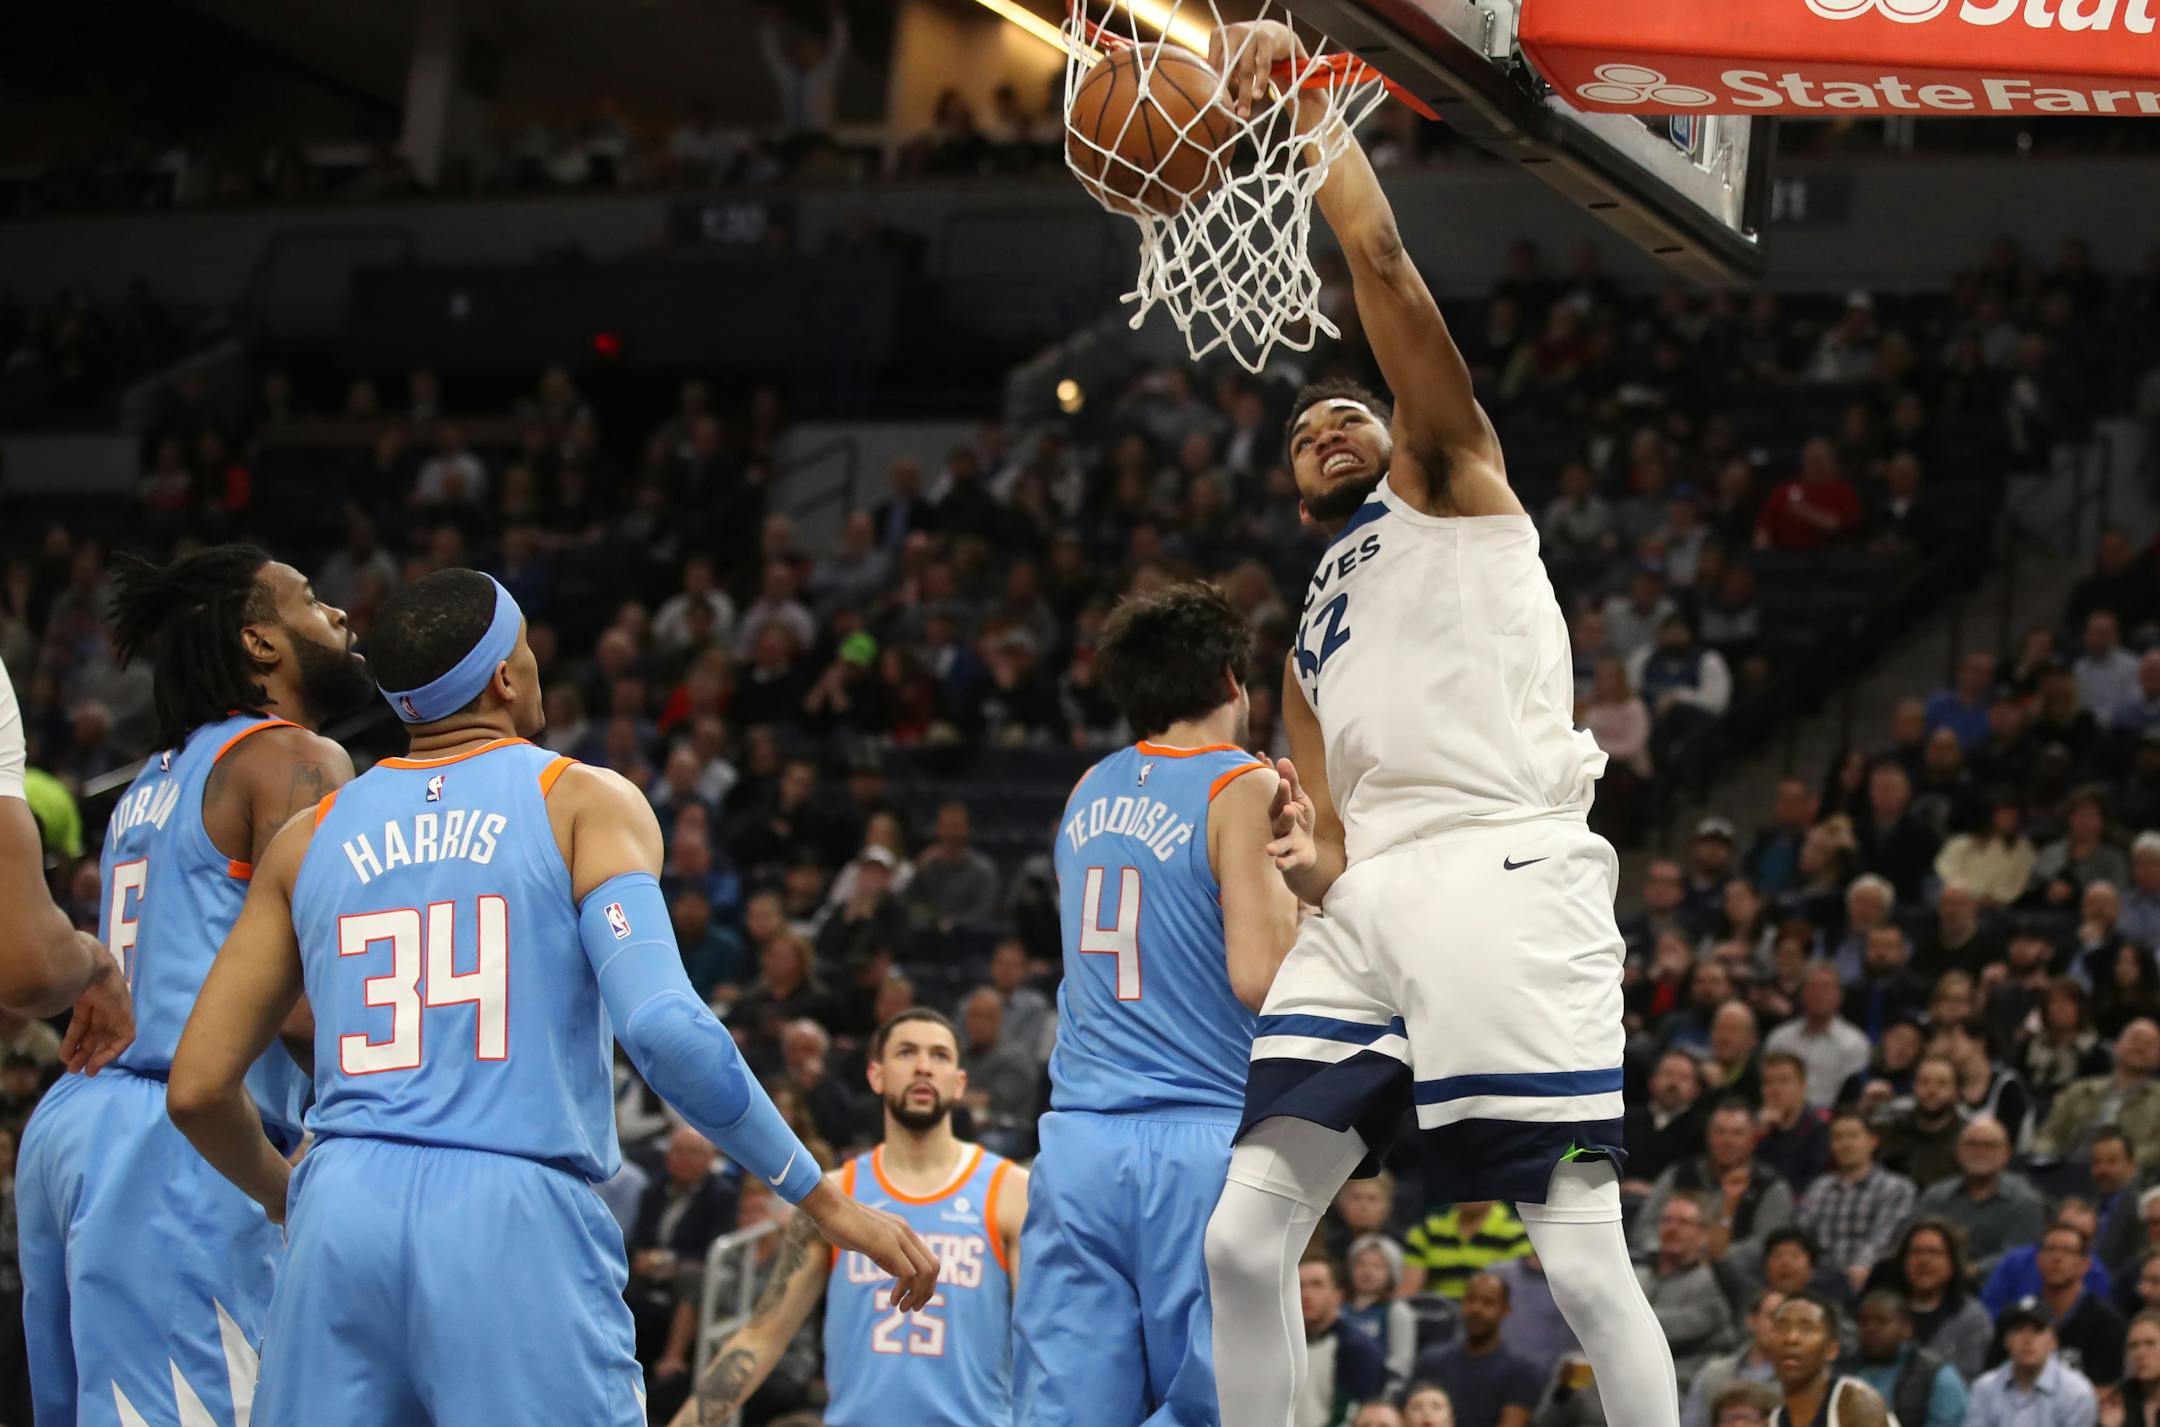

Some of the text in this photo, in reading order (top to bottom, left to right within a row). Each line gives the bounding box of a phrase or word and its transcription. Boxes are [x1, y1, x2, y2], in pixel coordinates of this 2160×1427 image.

[1303, 534, 1381, 613] VES
[342, 809, 507, 884] HARRIS
[1080, 866, 1142, 1001] 4
[338, 894, 509, 1077] 34
[872, 1289, 945, 1357] 25
